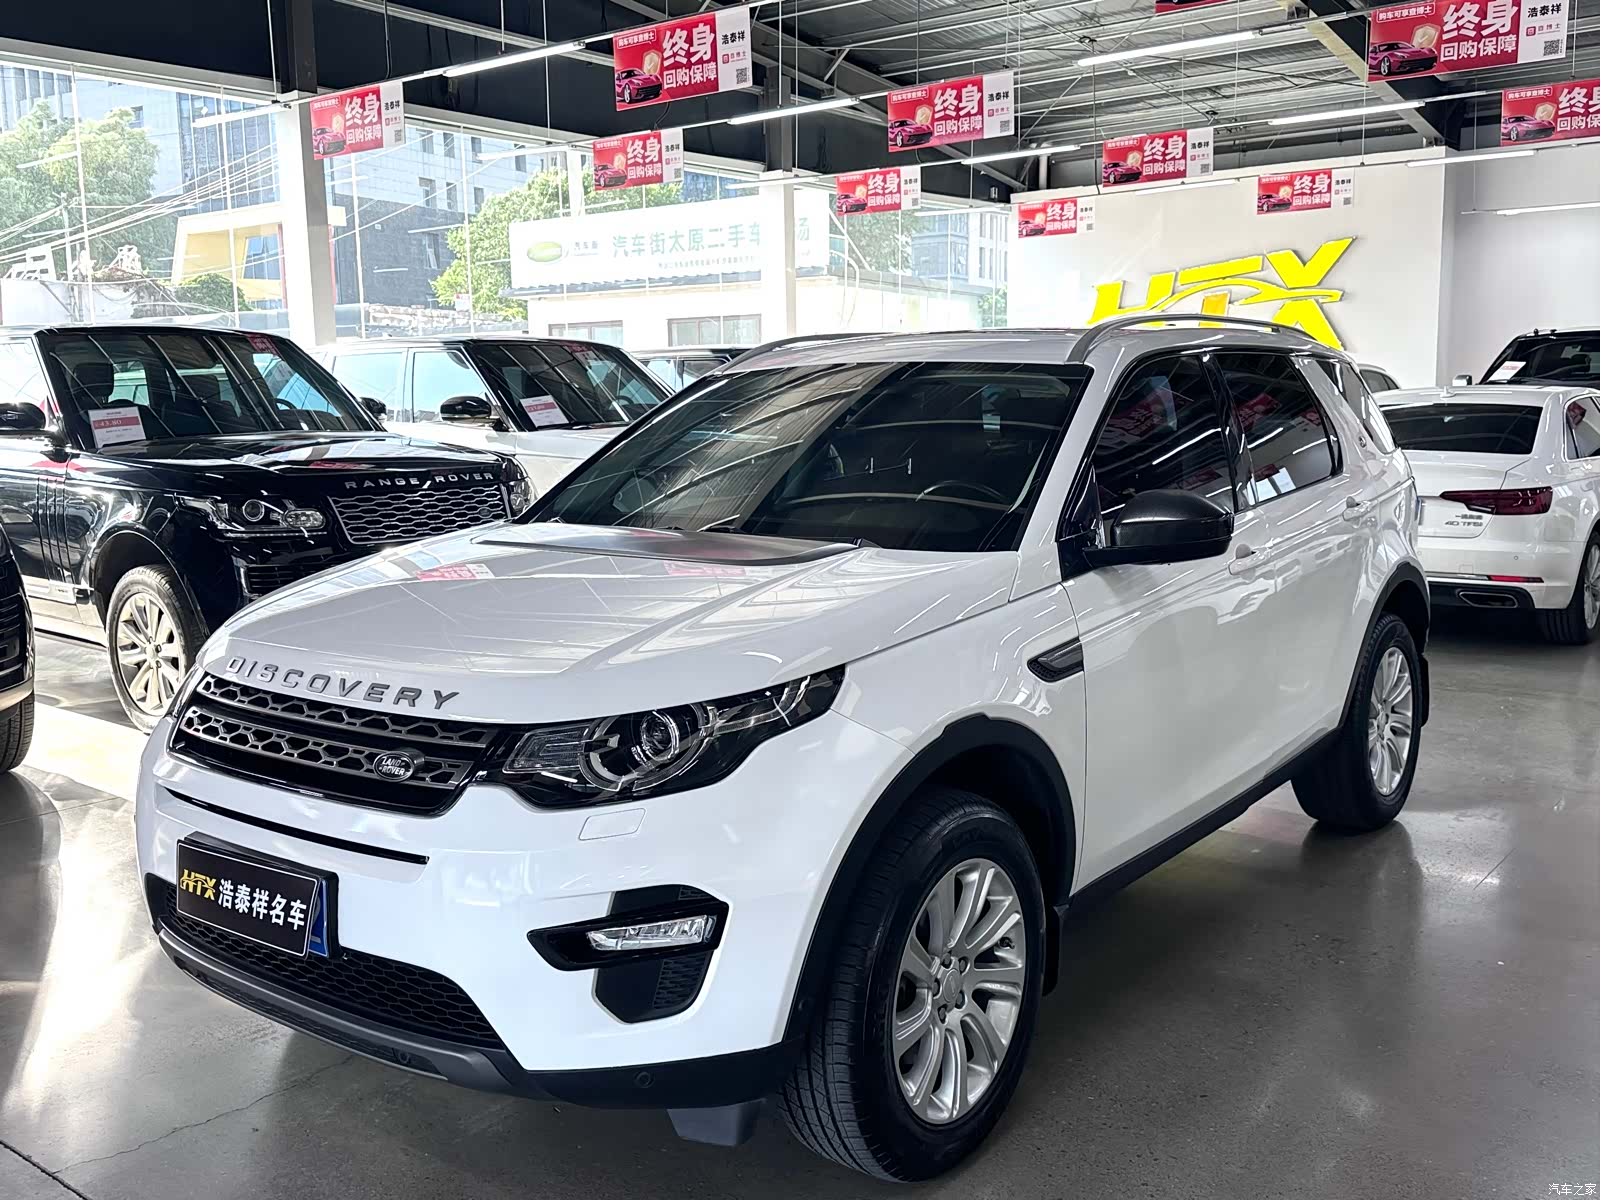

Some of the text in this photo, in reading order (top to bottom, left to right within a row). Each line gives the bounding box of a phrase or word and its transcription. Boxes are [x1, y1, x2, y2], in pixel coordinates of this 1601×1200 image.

[1442, 0, 1519, 41] 终身
[1527, 3, 1562, 18] 浩泰祥
[662, 23, 715, 67] 终身
[721, 30, 745, 45] 浩泰祥
[1440, 34, 1517, 62] 回购保障
[663, 62, 717, 89] 回购保障
[934, 84, 982, 119] 终身
[988, 91, 1010, 102] 浩泰祥
[344, 93, 380, 127] 终身
[346, 124, 382, 143] 回购保障
[934, 115, 983, 136] 回购保障
[626, 137, 660, 165] 终身
[1144, 135, 1185, 162] 终身
[627, 163, 662, 179] 回购保障
[1143, 159, 1185, 176] 回购保障
[867, 171, 900, 194] 终身
[1293, 173, 1330, 194] 终身
[1292, 193, 1331, 206] 回购保障
[1046, 201, 1076, 221] 终身
[344, 472, 494, 489] RANGE ROVER
[225, 656, 459, 710] DISCOVERY
[381, 756, 402, 767] LAND
[382, 765, 406, 776] ROVER
[218, 878, 307, 931] 浩泰祥名车
